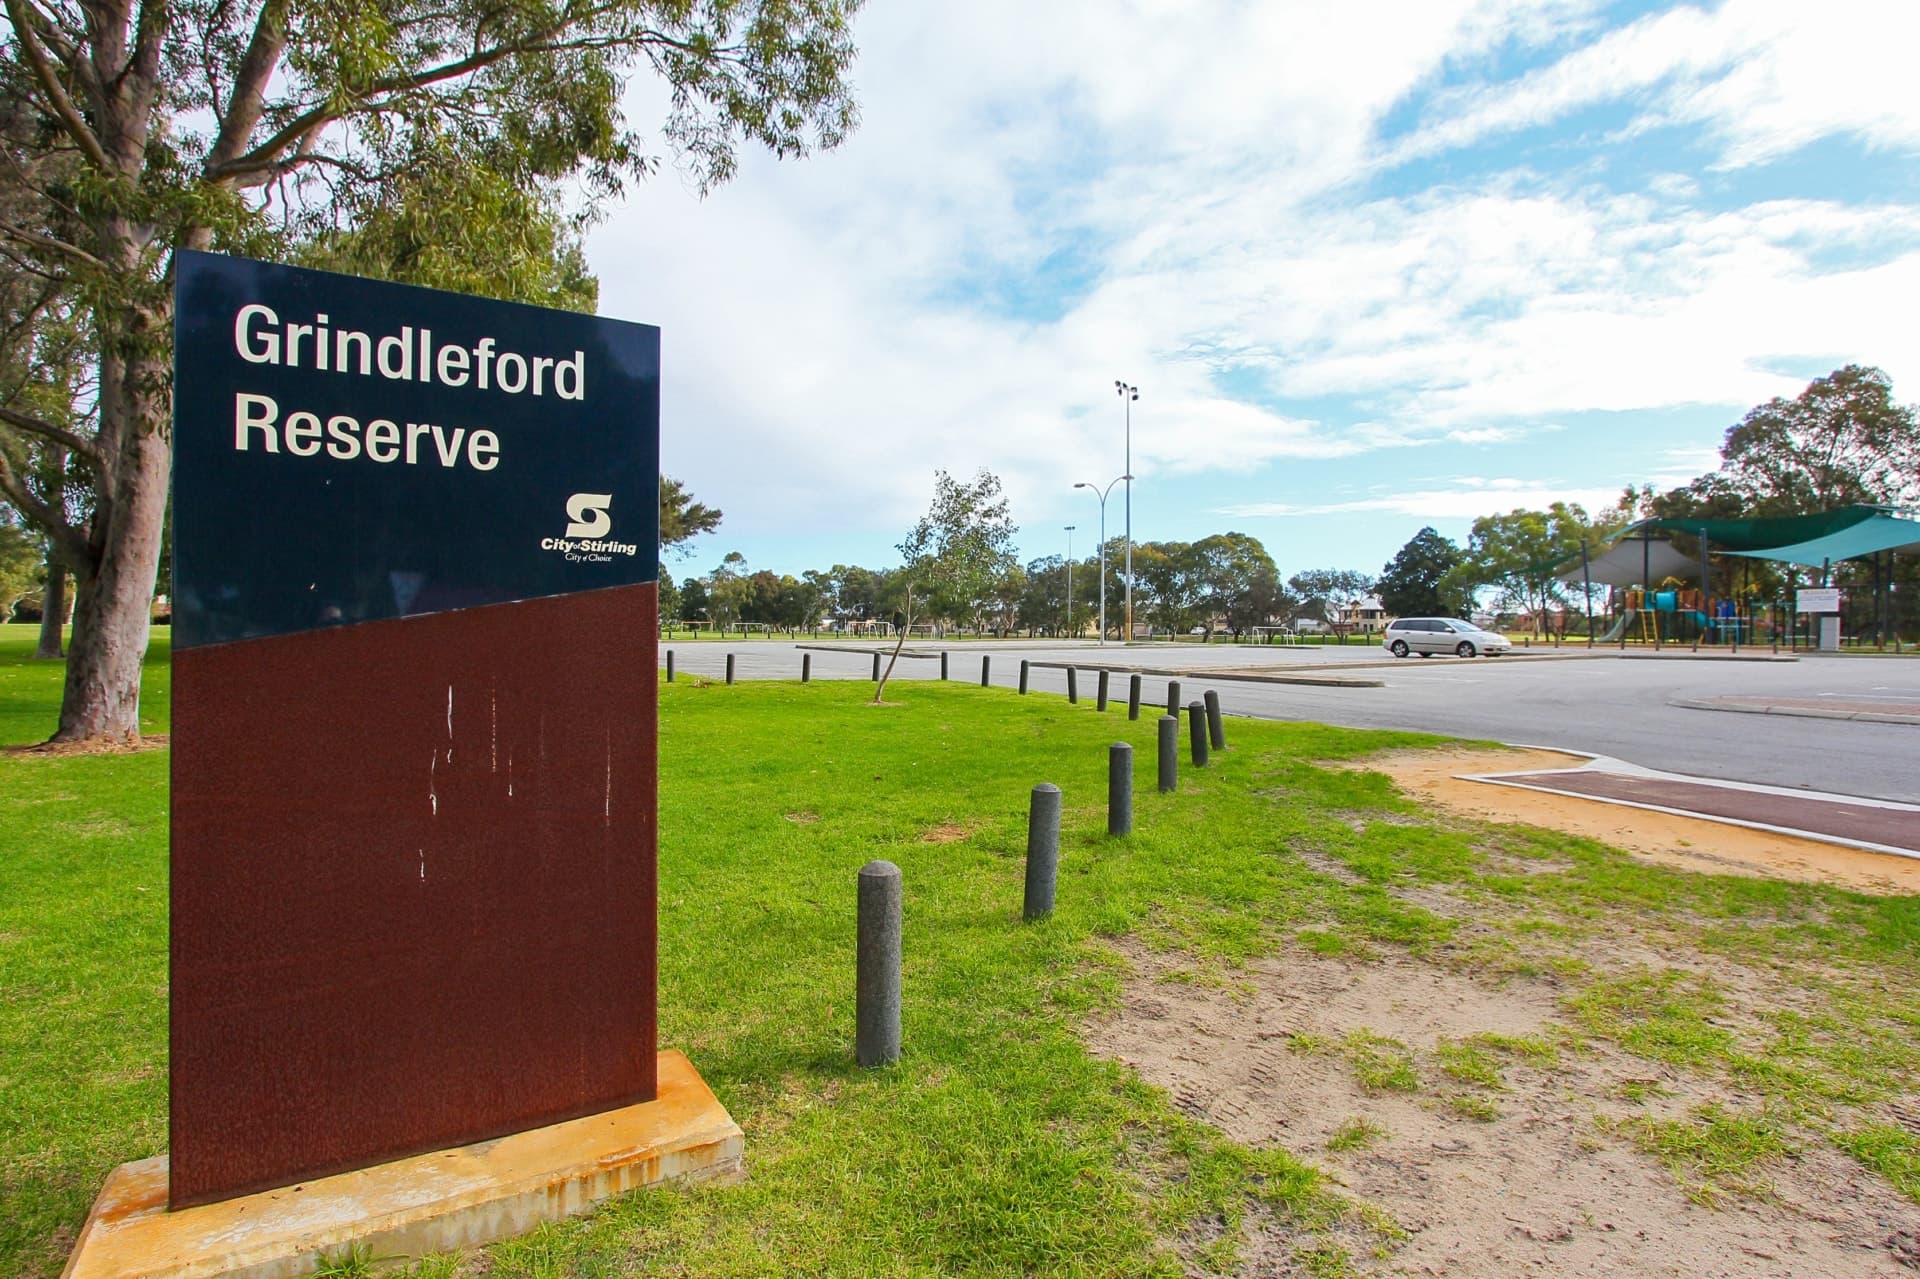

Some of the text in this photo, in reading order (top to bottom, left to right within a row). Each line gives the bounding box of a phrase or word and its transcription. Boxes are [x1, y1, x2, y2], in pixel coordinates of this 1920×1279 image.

[234, 303, 585, 401] Grindleford
[234, 392, 500, 472] Reserve
[565, 552, 581, 563] City
[588, 553, 612, 562] Choice
